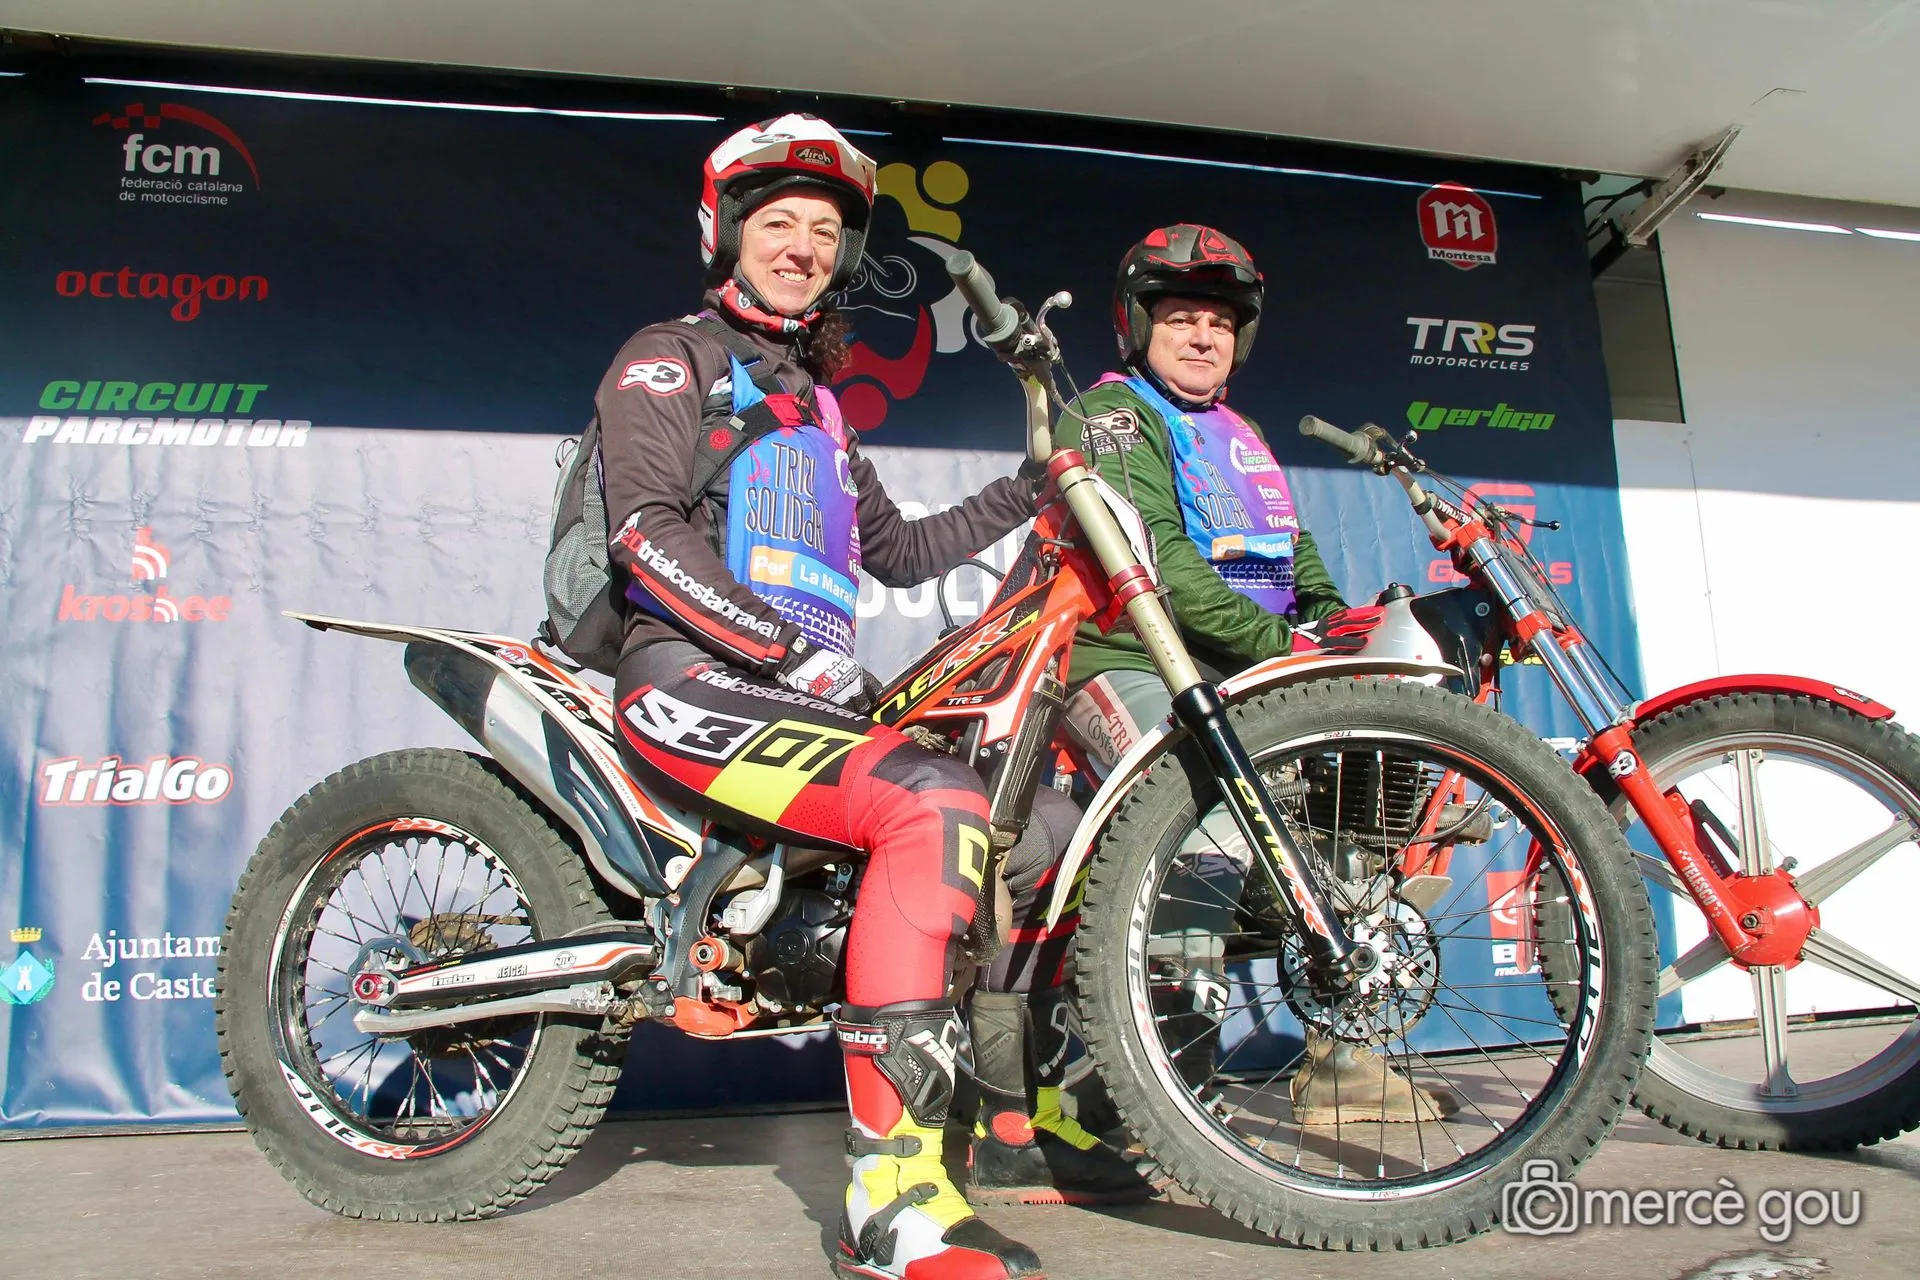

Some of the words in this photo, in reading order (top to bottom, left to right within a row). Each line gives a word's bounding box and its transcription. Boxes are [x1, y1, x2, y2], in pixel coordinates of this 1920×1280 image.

[123, 134, 220, 175] fcm
[119, 191, 136, 201] de
[141, 193, 228, 205] motociclisme
[187, 180, 243, 192] catalana
[1432, 249, 1491, 262] Montesa
[55, 266, 268, 322] octagon
[1410, 355, 1530, 371] MOTORCYCLES
[38, 380, 268, 412] CIRCUIT
[23, 416, 312, 447] PARCMOTOR
[753, 555, 789, 577] Per
[799, 564, 819, 587] La
[45, 758, 229, 801] TrialGo
[1682, 860, 1718, 905] TELESCO
[81, 930, 220, 967] Ajuntam
[82, 972, 120, 1001] de
[130, 973, 217, 1000] Caste
